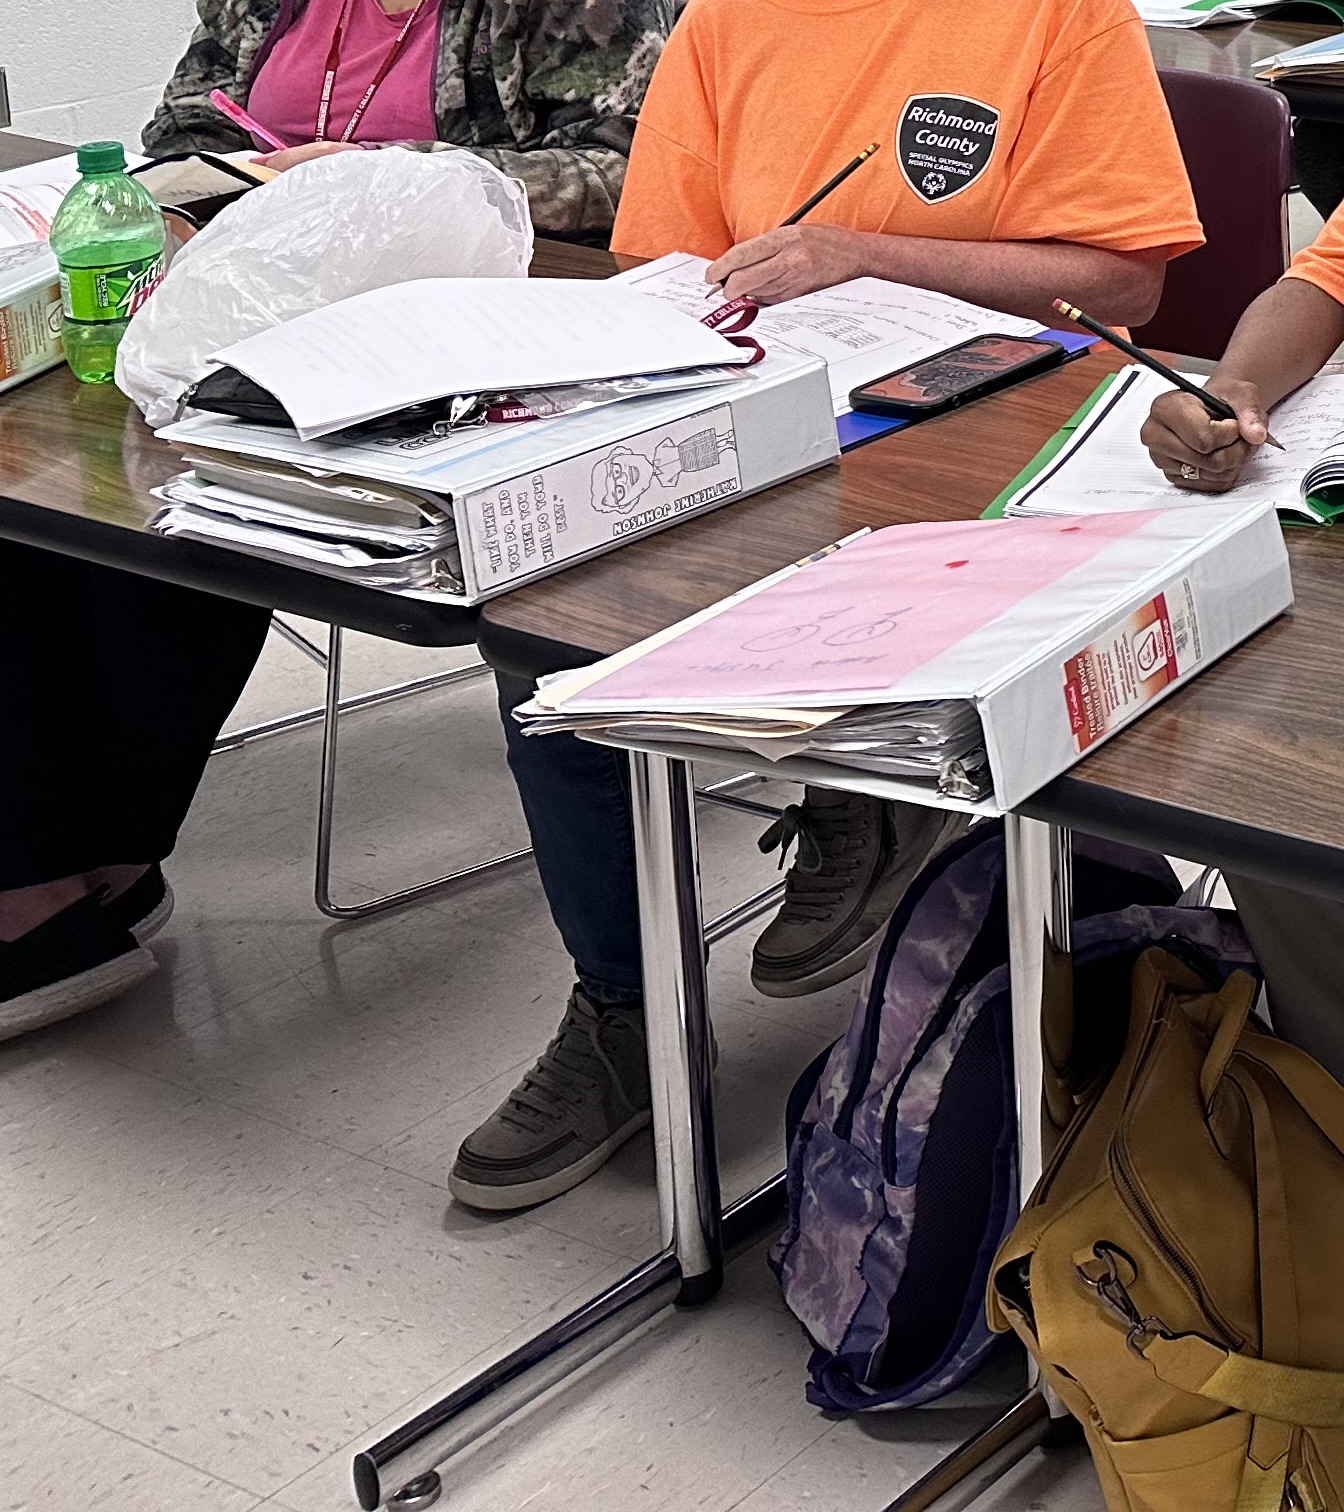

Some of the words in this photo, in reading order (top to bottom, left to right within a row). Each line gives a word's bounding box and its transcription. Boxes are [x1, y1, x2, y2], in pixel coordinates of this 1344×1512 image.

[908, 106, 999, 136] Richmond
[915, 129, 980, 156] County
[907, 158, 933, 169] NORTH
[934, 163, 971, 177] CAROLINA
[909, 151, 938, 163] SPECIAL
[938, 157, 974, 170] OLYMPICS
[499, 489, 513, 516] AND
[517, 492, 530, 520] YOU
[532, 474, 546, 511] YOUR
[674, 477, 738, 512] KATHERINE
[613, 503, 671, 536] JOHNSON
[522, 523, 536, 558] THEN
[540, 532, 554, 563] WILL
[507, 543, 520, 573] YOU
[1077, 657, 1090, 696] Binder
[1081, 695, 1097, 739] Treated
